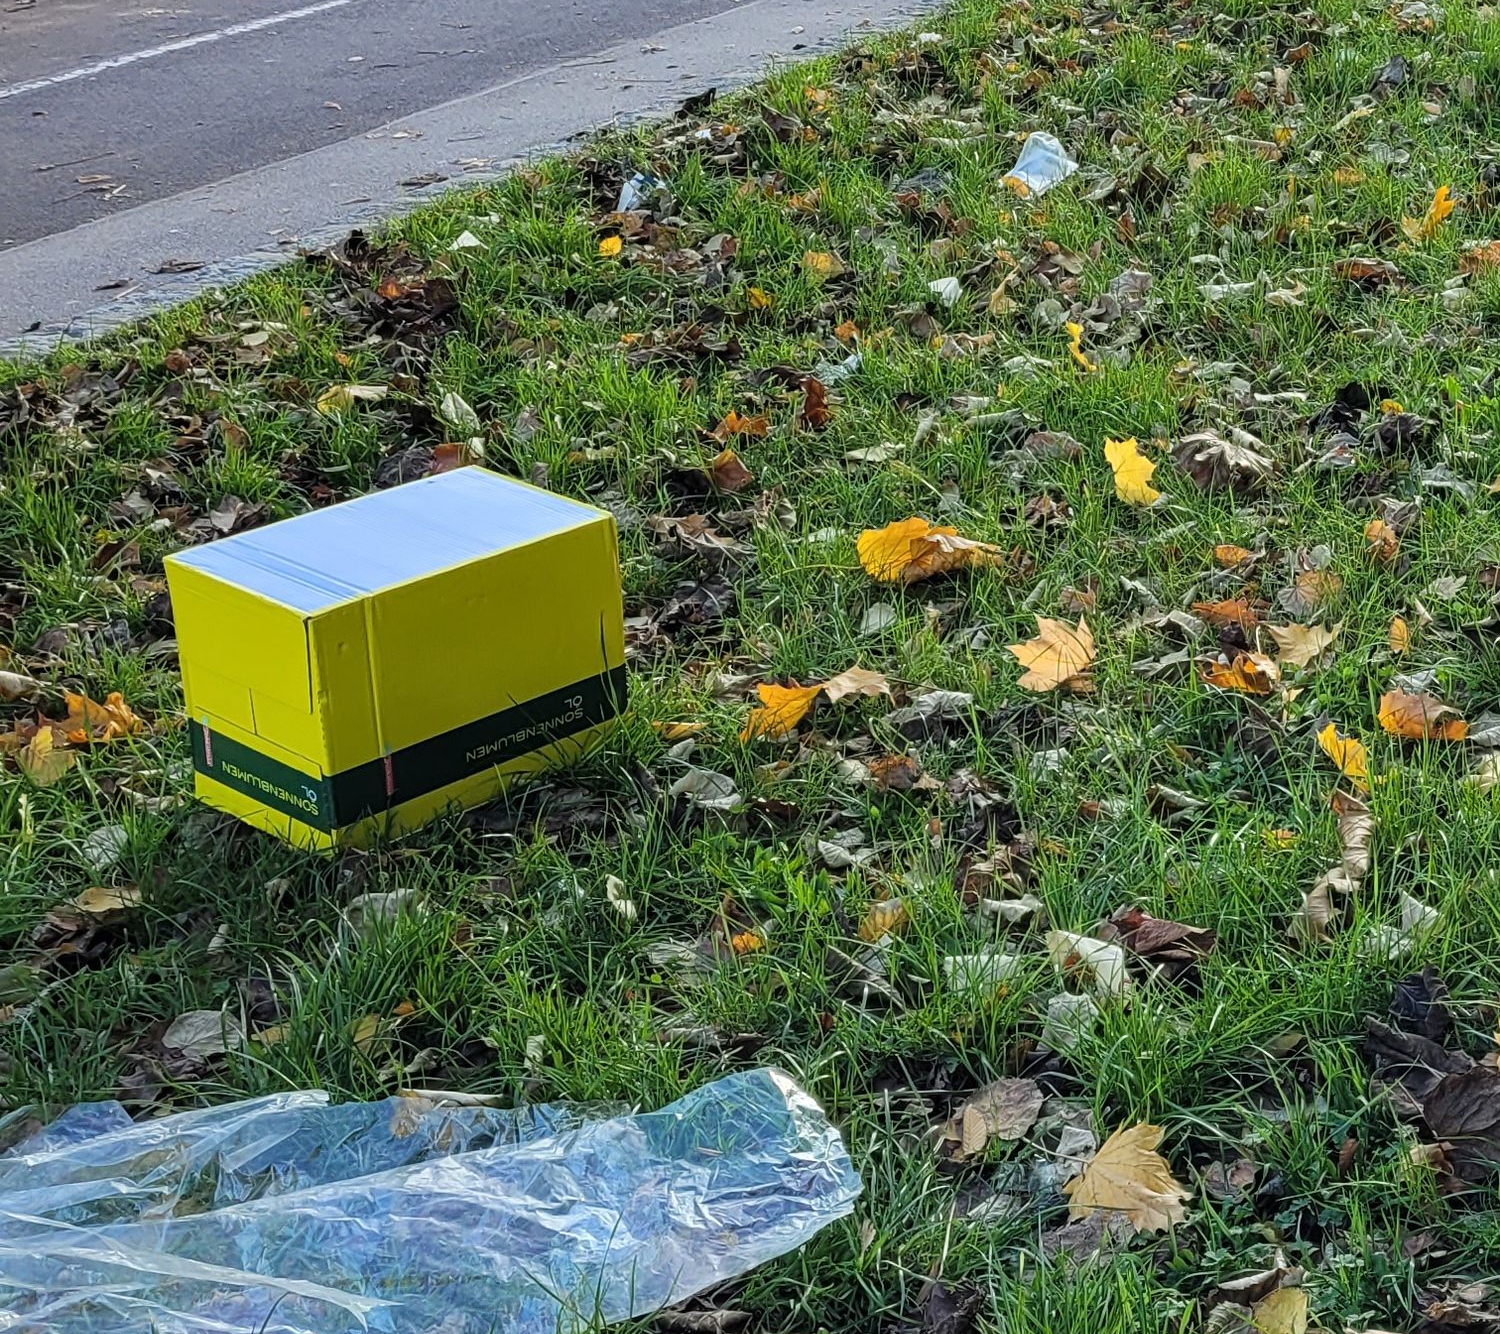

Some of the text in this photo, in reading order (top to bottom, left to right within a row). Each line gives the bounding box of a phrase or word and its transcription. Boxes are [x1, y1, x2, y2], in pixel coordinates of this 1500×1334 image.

[564, 695, 583, 709] ÖL
[466, 708, 584, 762] SONNENBLUMEN
[222, 761, 319, 816] SONNENBLUMEN
[301, 785, 317, 801] ÖL
